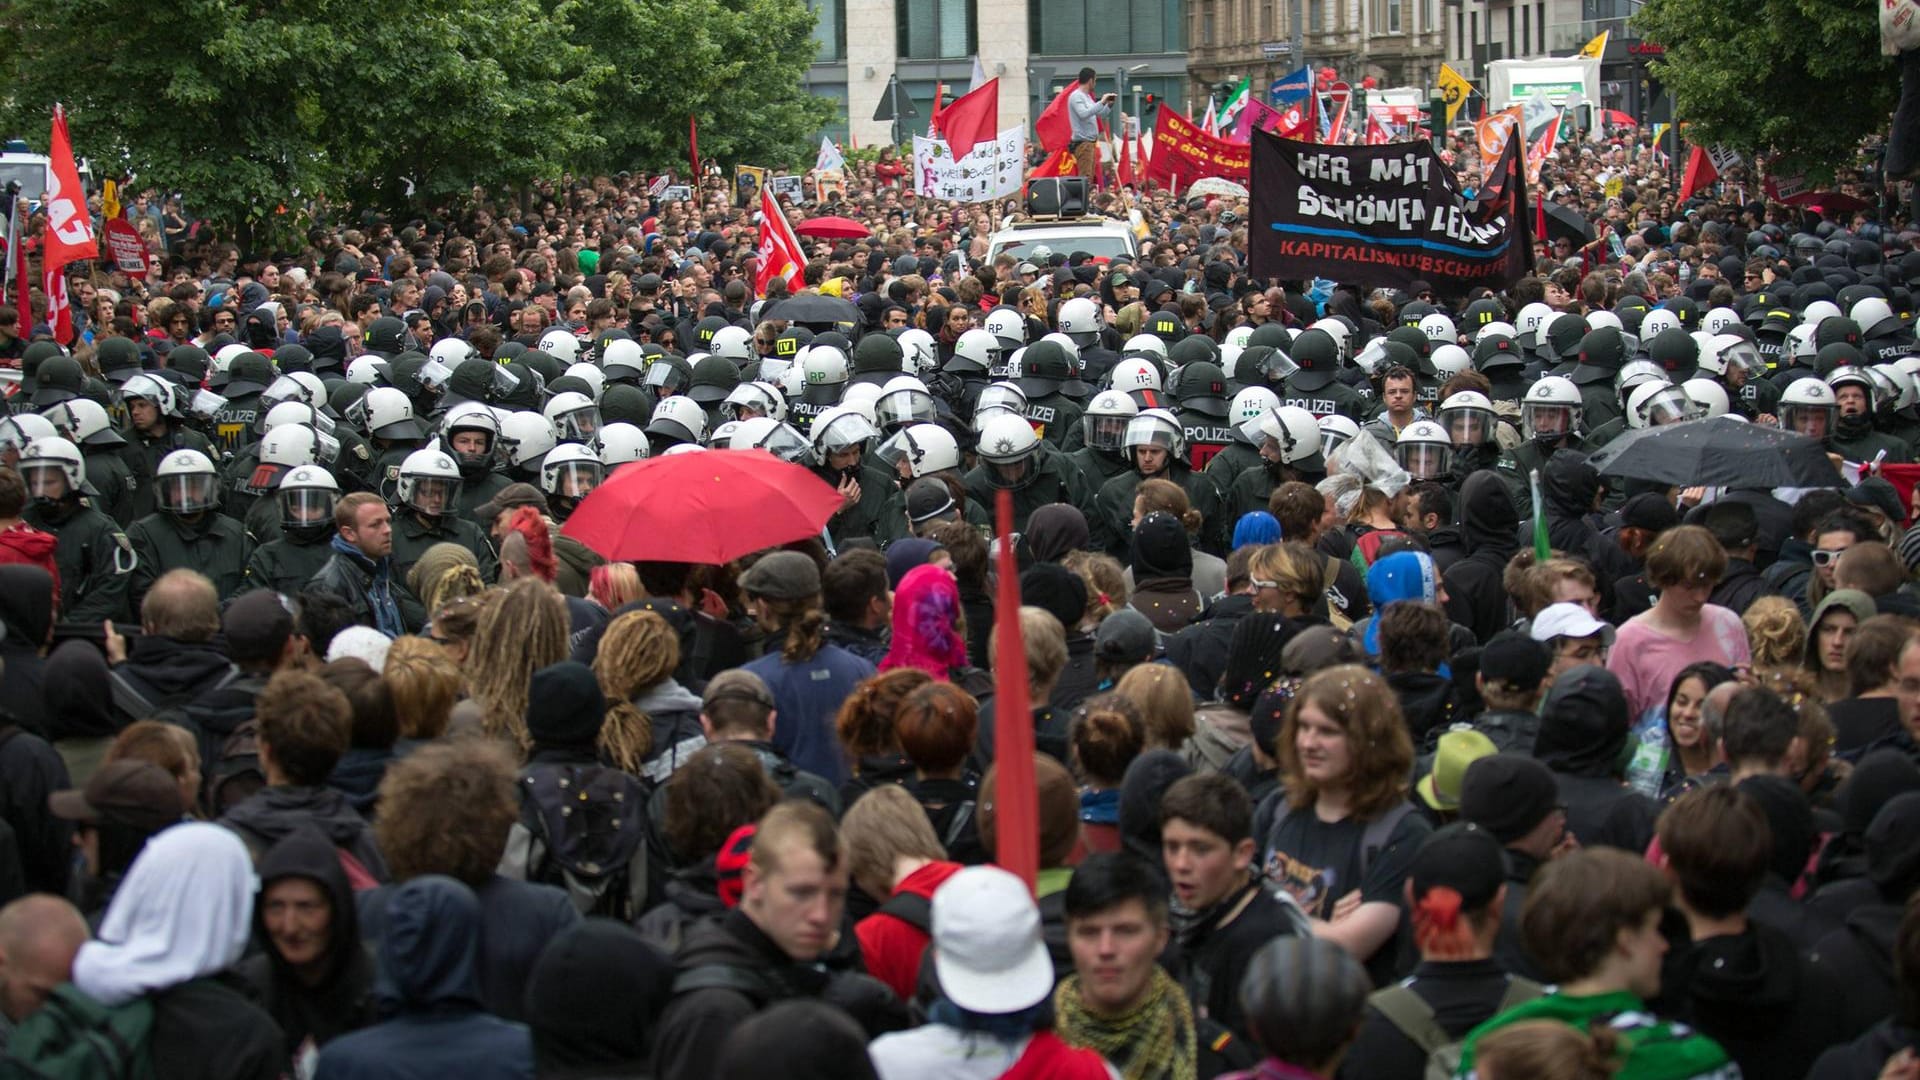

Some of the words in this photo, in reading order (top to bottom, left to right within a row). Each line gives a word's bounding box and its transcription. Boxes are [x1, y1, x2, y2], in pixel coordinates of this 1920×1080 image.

[1298, 153, 1351, 186] HER
[1298, 184, 1425, 231] SCHÖNEN
[988, 323, 1003, 334] RP
[810, 371, 826, 382] RP
[213, 408, 257, 423] POLIZEI
[1026, 403, 1055, 423] LIZEI
